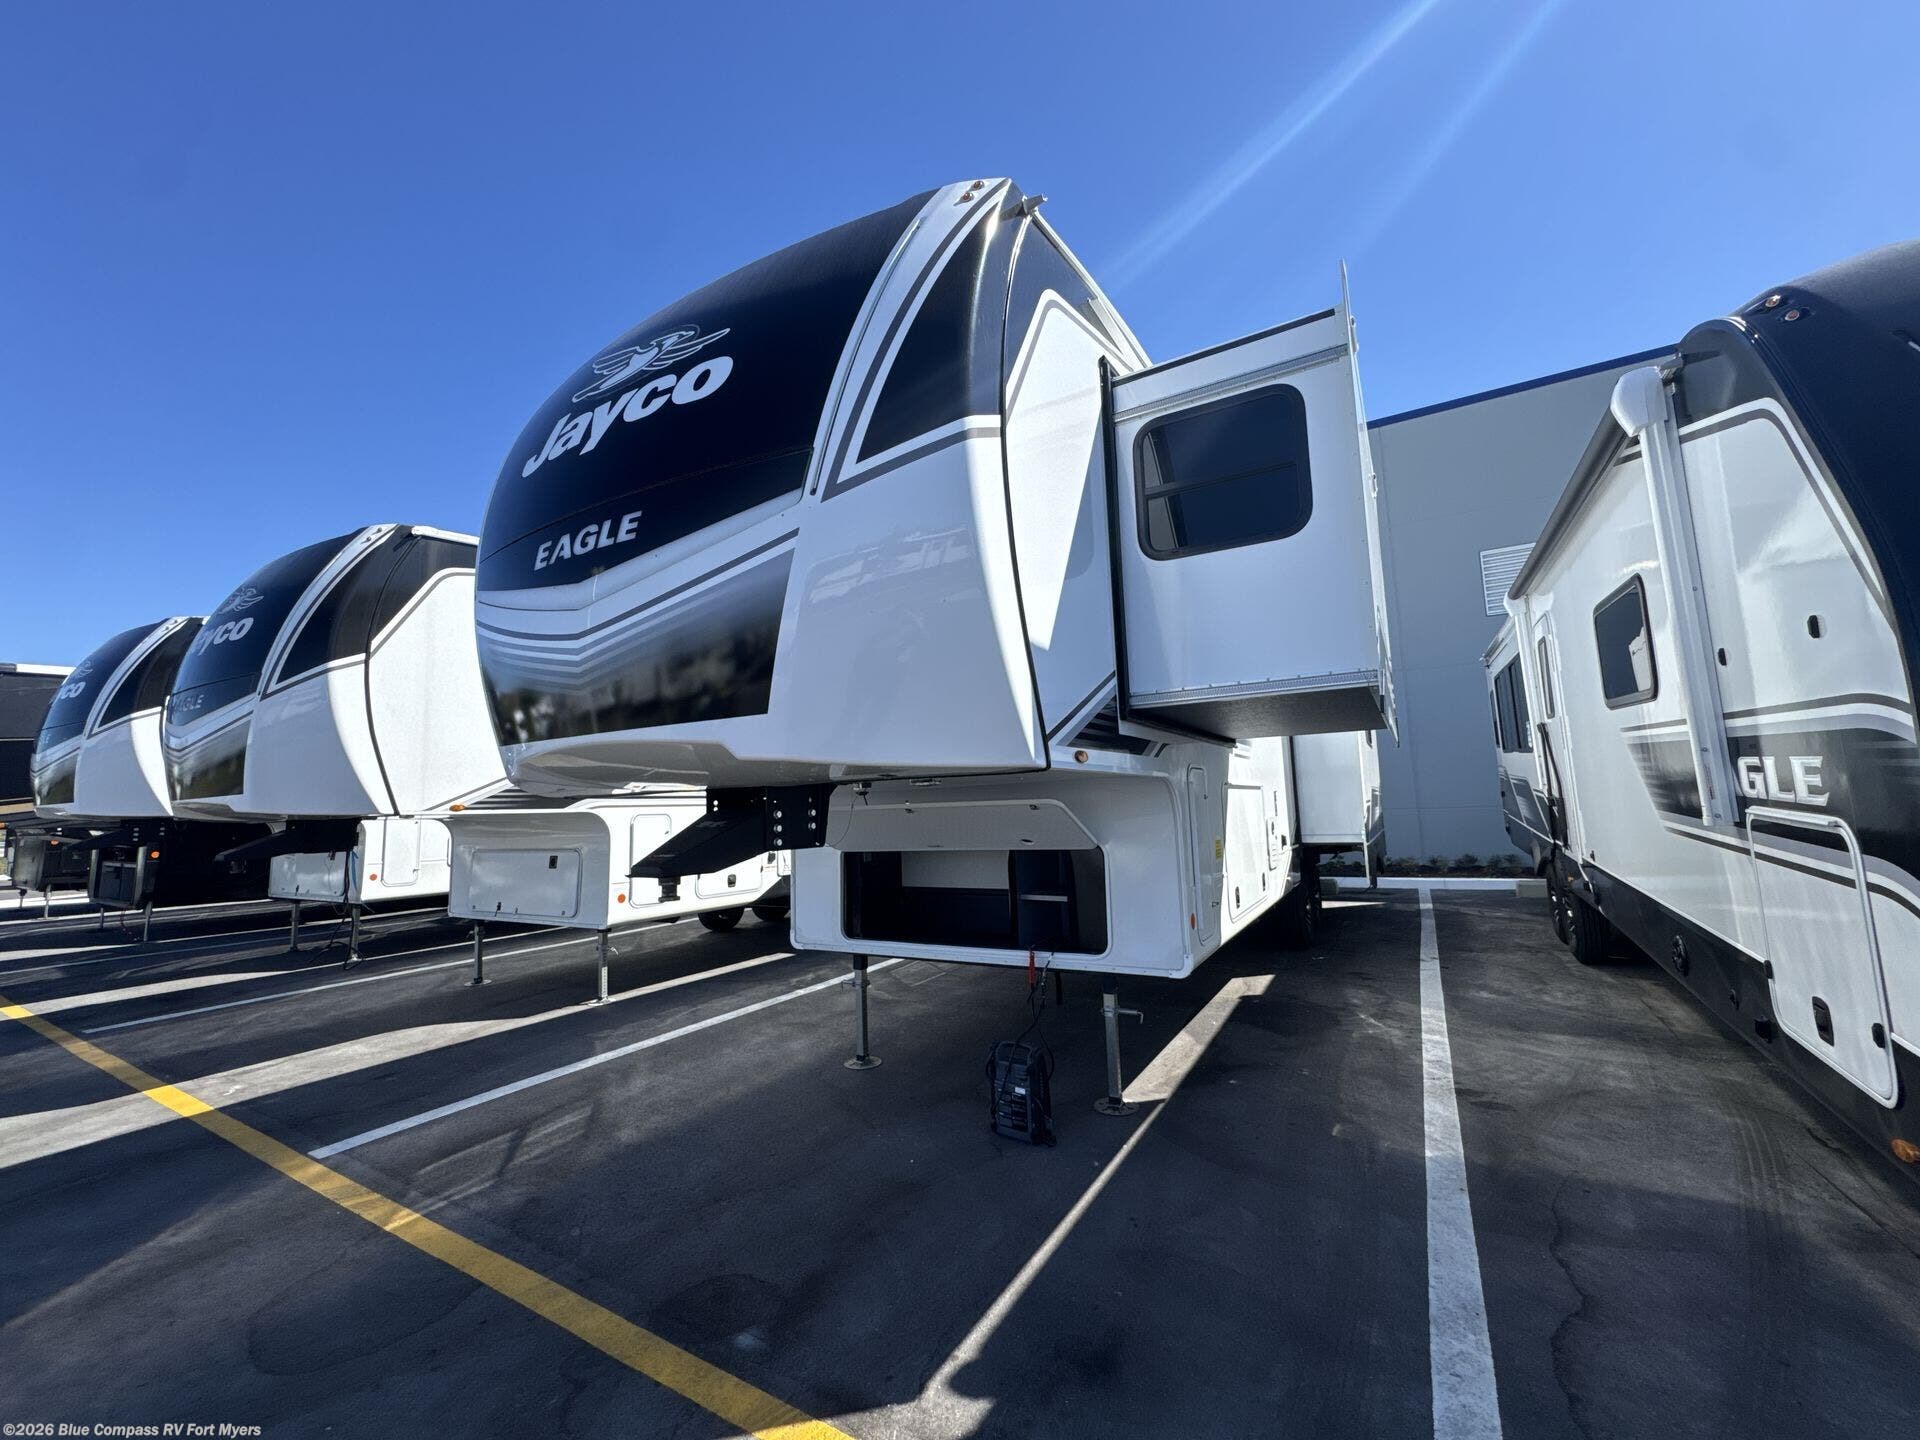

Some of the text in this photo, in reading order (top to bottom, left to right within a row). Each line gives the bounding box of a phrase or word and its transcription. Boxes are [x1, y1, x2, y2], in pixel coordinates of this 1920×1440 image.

[522, 356, 734, 478] Jayco
[534, 510, 642, 571] EAGLE
[1732, 756, 1830, 806] GLE
